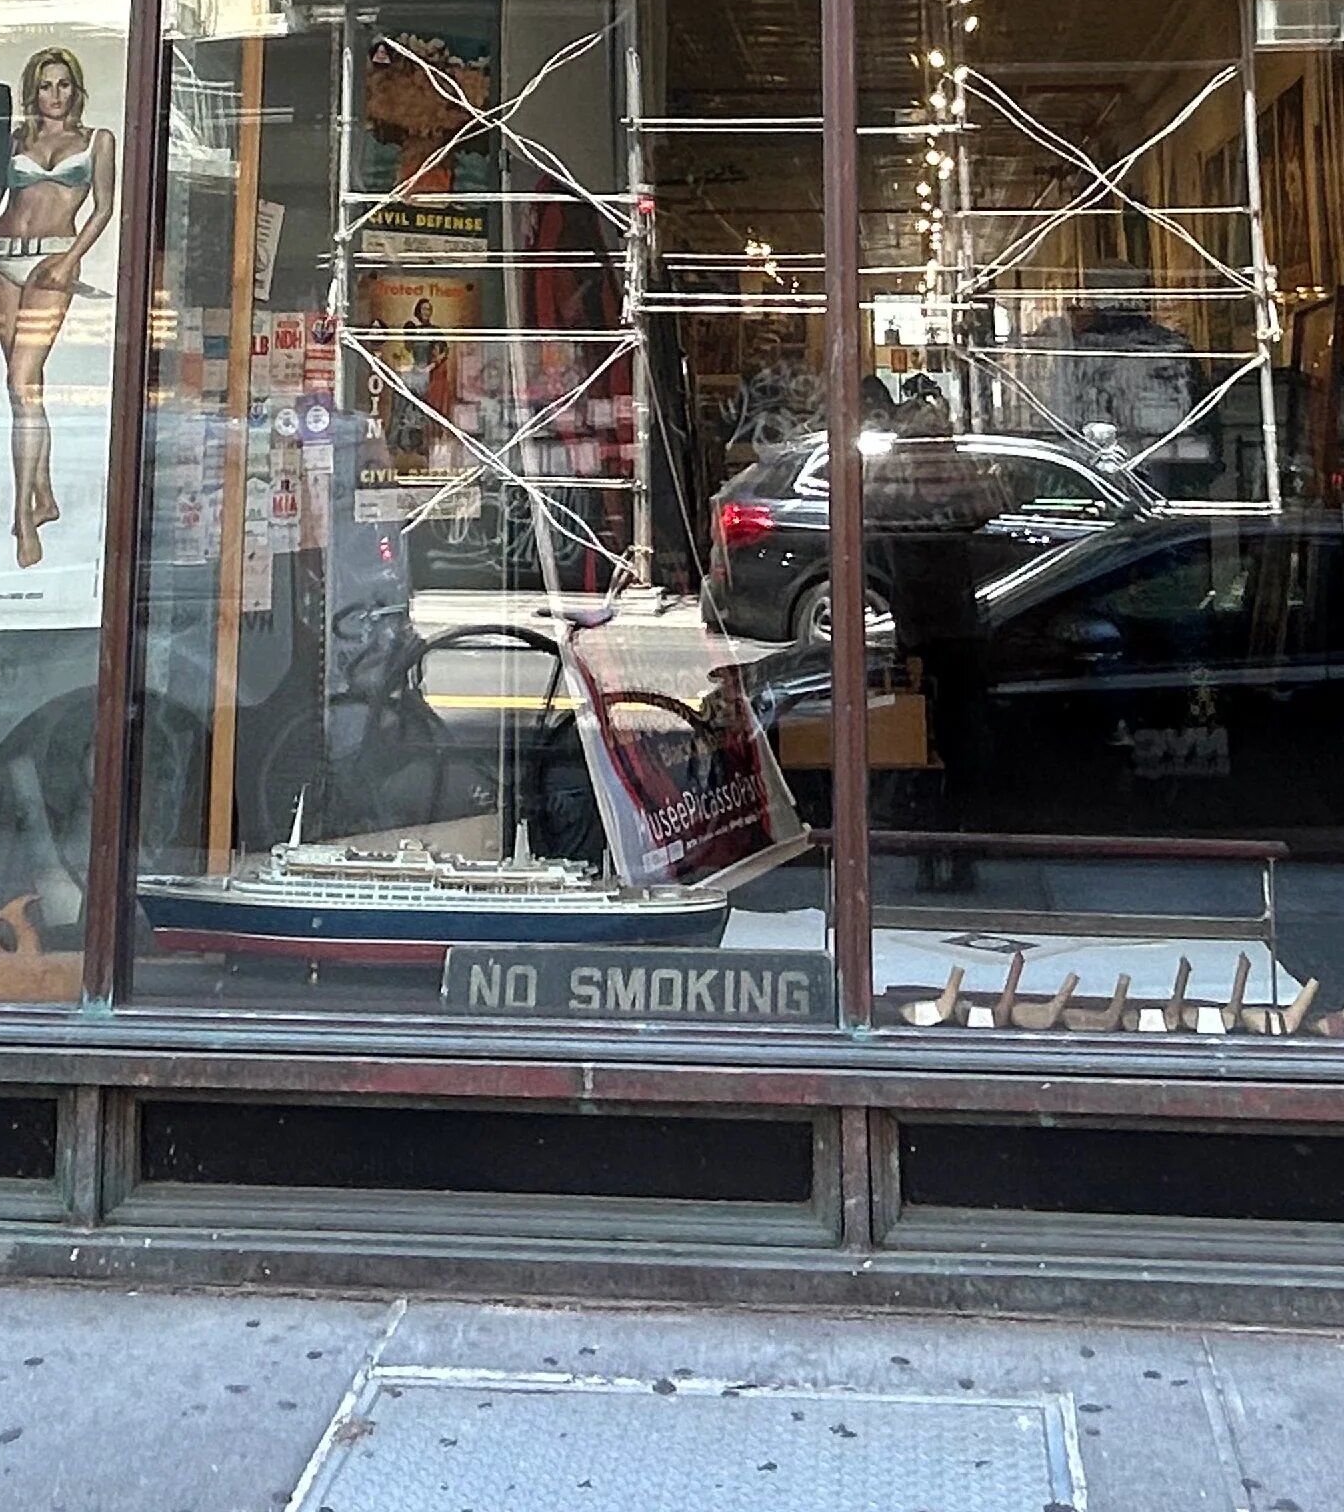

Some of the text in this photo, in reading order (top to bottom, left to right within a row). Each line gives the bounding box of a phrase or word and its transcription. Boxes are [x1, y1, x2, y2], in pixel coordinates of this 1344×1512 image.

[416, 214, 483, 232] DEFENSE
[469, 963, 810, 1016] NO SMOKING
